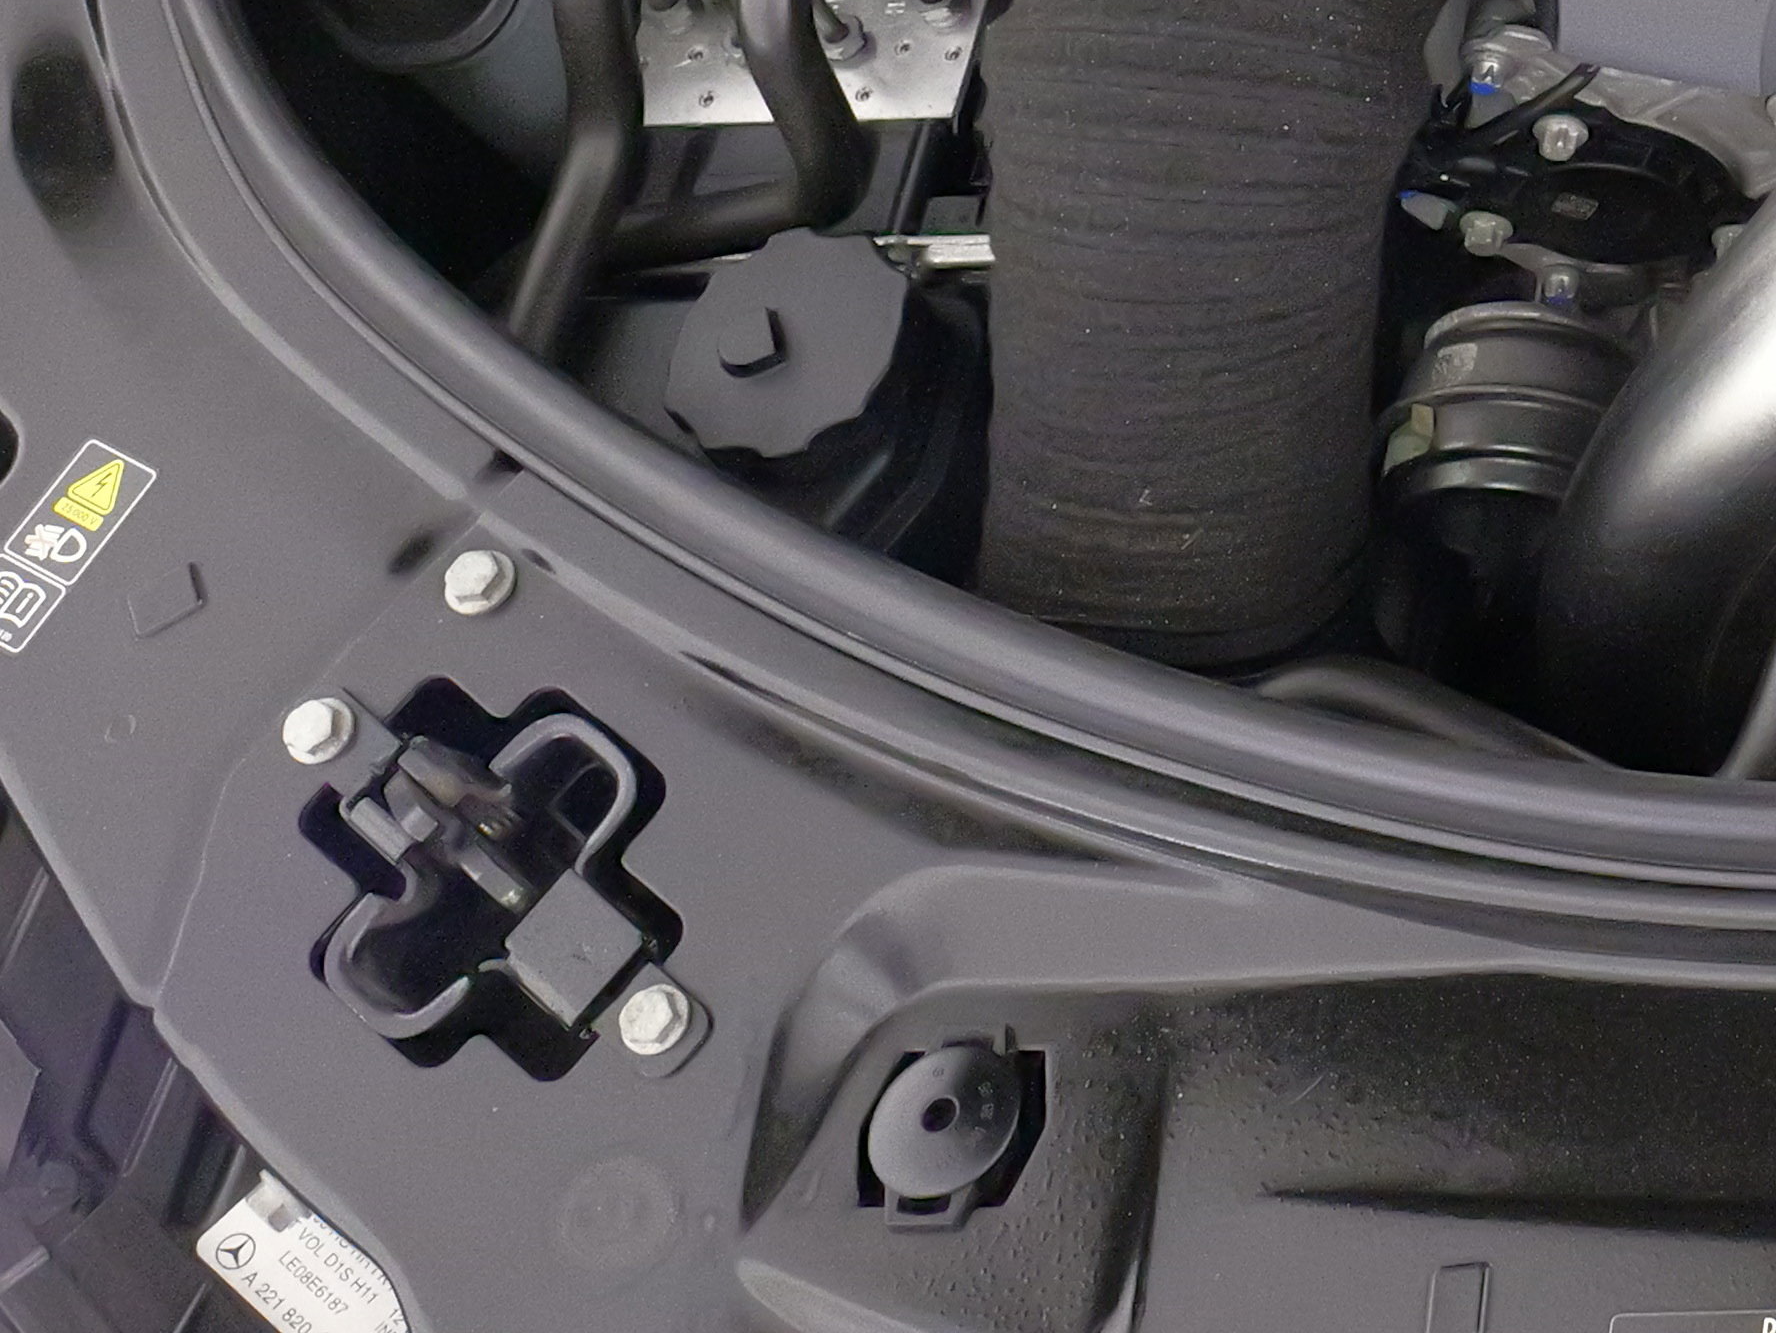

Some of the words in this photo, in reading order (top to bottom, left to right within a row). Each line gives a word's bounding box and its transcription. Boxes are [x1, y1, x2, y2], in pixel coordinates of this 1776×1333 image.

[240, 1272, 260, 1289] A
[254, 1283, 286, 1311] 221
[277, 1249, 349, 1315] LE08E6187
[324, 1251, 355, 1282] D1S
[350, 1277, 379, 1305] H11
